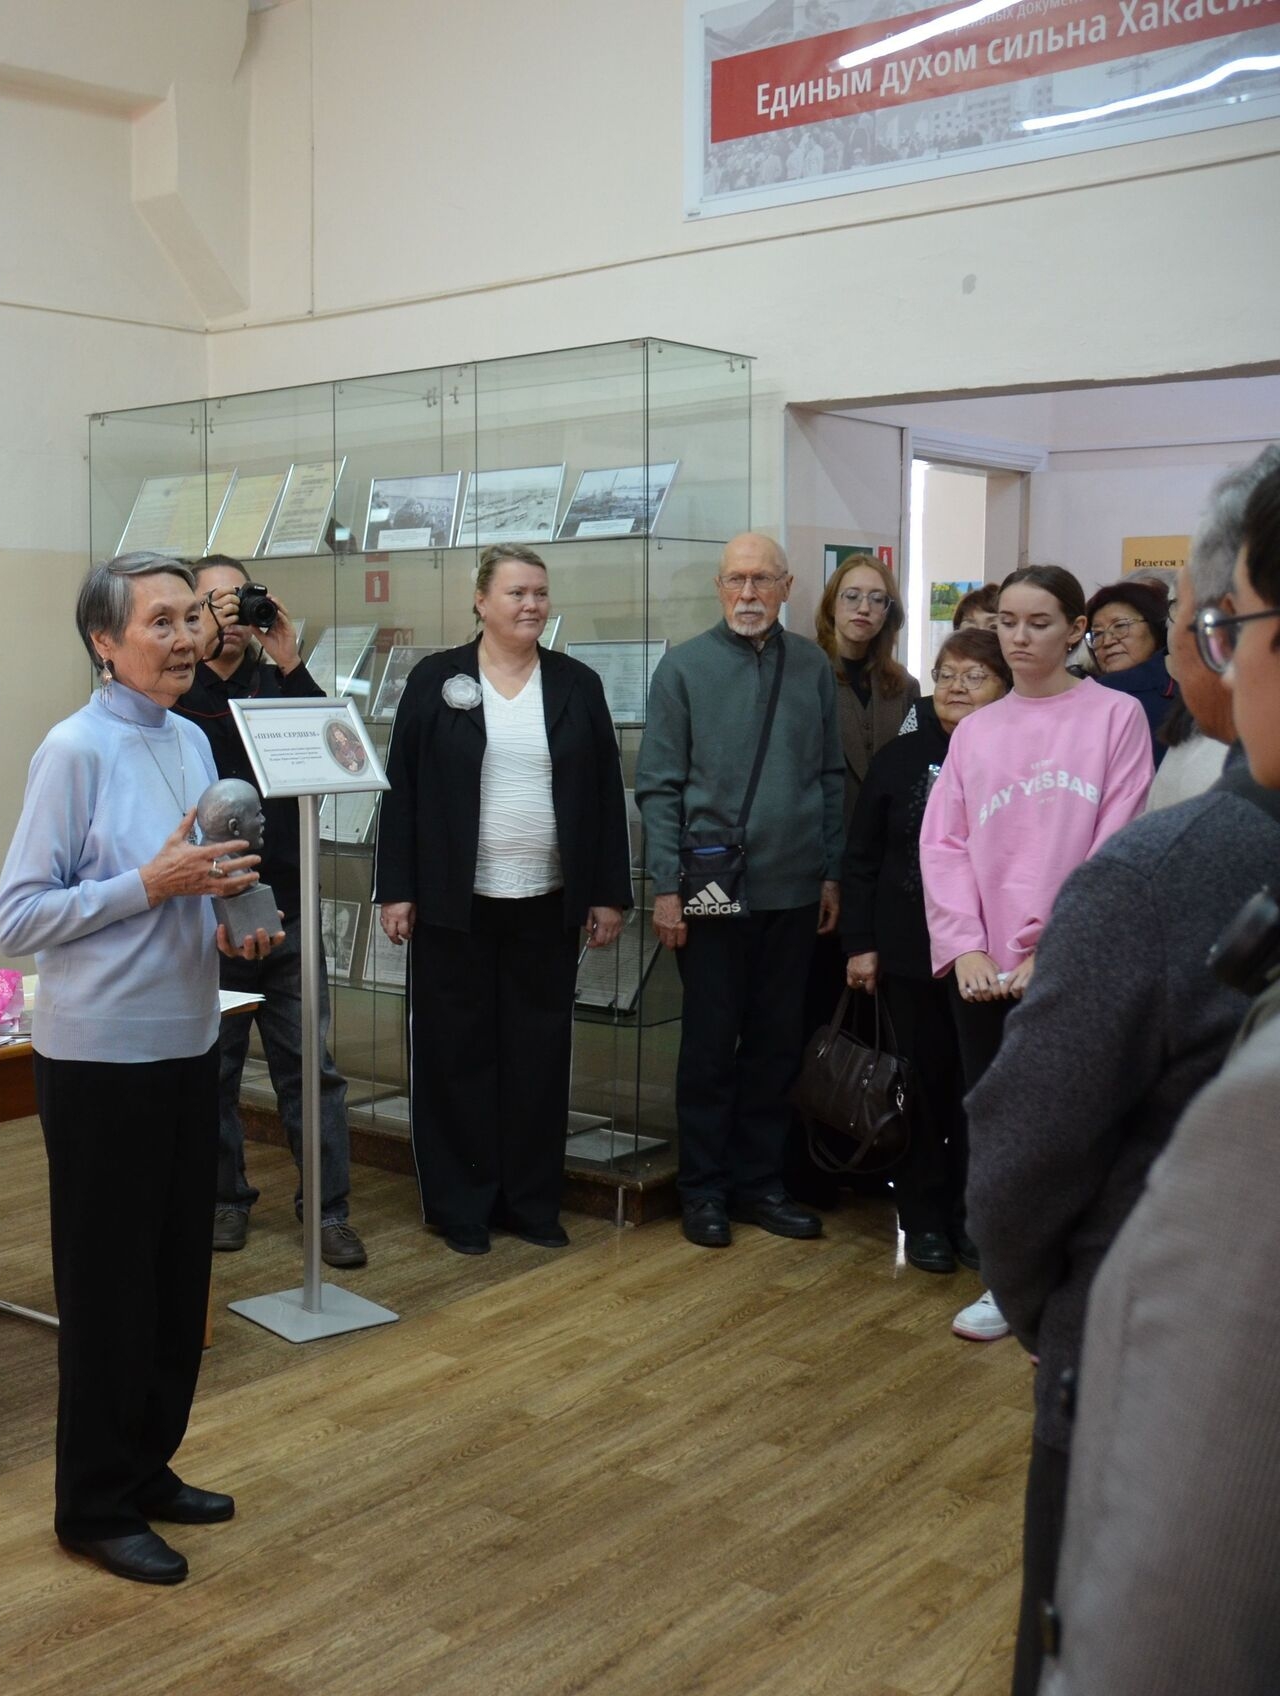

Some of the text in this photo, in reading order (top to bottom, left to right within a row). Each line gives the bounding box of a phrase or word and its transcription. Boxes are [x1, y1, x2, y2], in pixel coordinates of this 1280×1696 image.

[756, 68, 872, 120] Единым
[880, 43, 977, 97] духом
[987, 13, 1107, 67] сильна
[1117, 0, 1272, 37] Хакас
[684, 902, 741, 915] adidas
